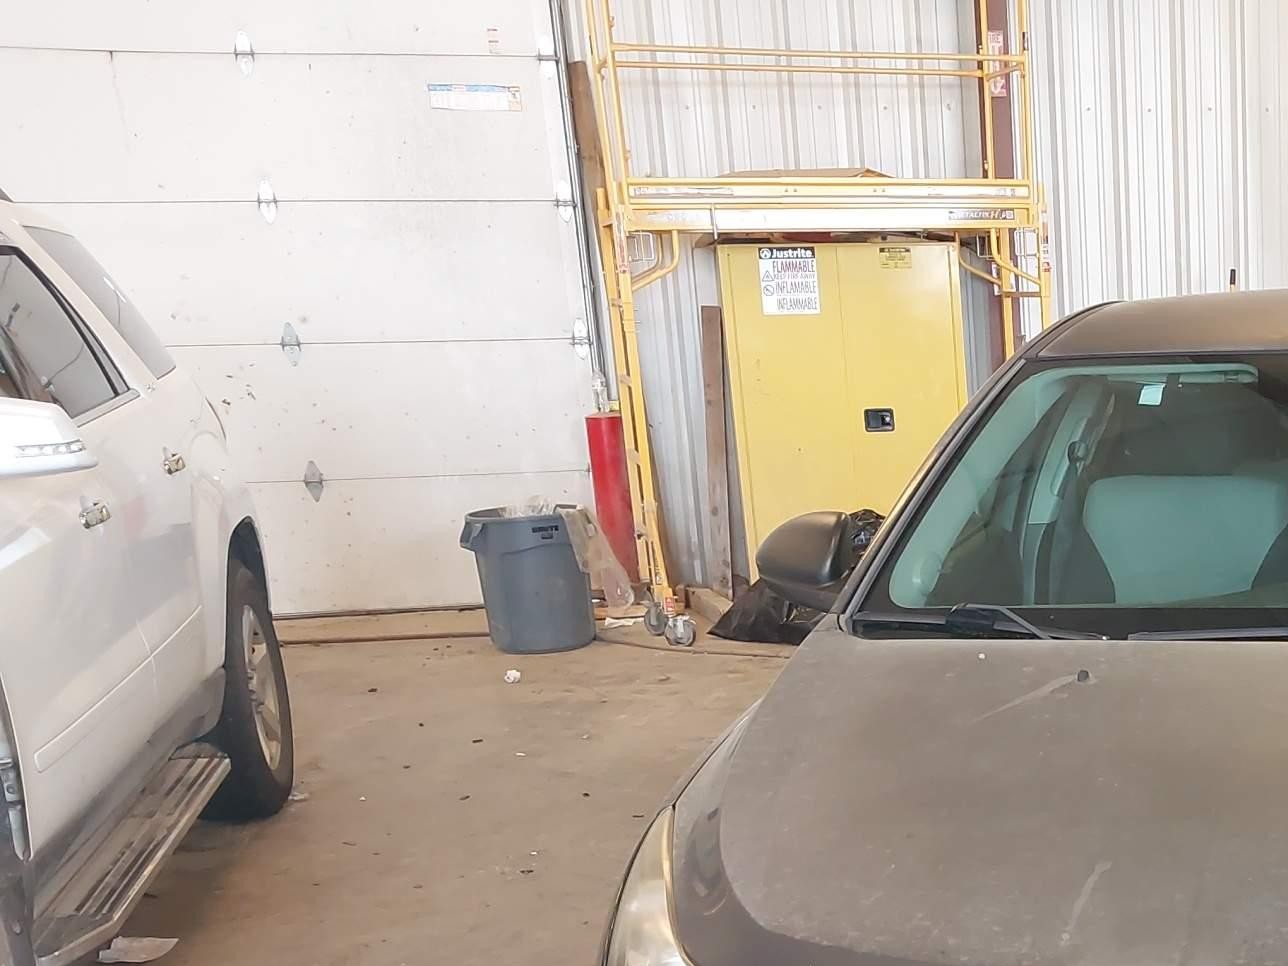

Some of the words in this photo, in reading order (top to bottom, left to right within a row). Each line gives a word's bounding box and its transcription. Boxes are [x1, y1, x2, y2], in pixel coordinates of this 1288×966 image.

[772, 248, 812, 258] Justrite
[772, 260, 815, 273] FLAMMABLE
[775, 281, 816, 294] INFLAMABLE
[776, 297, 817, 310] INFLAMMABLE
